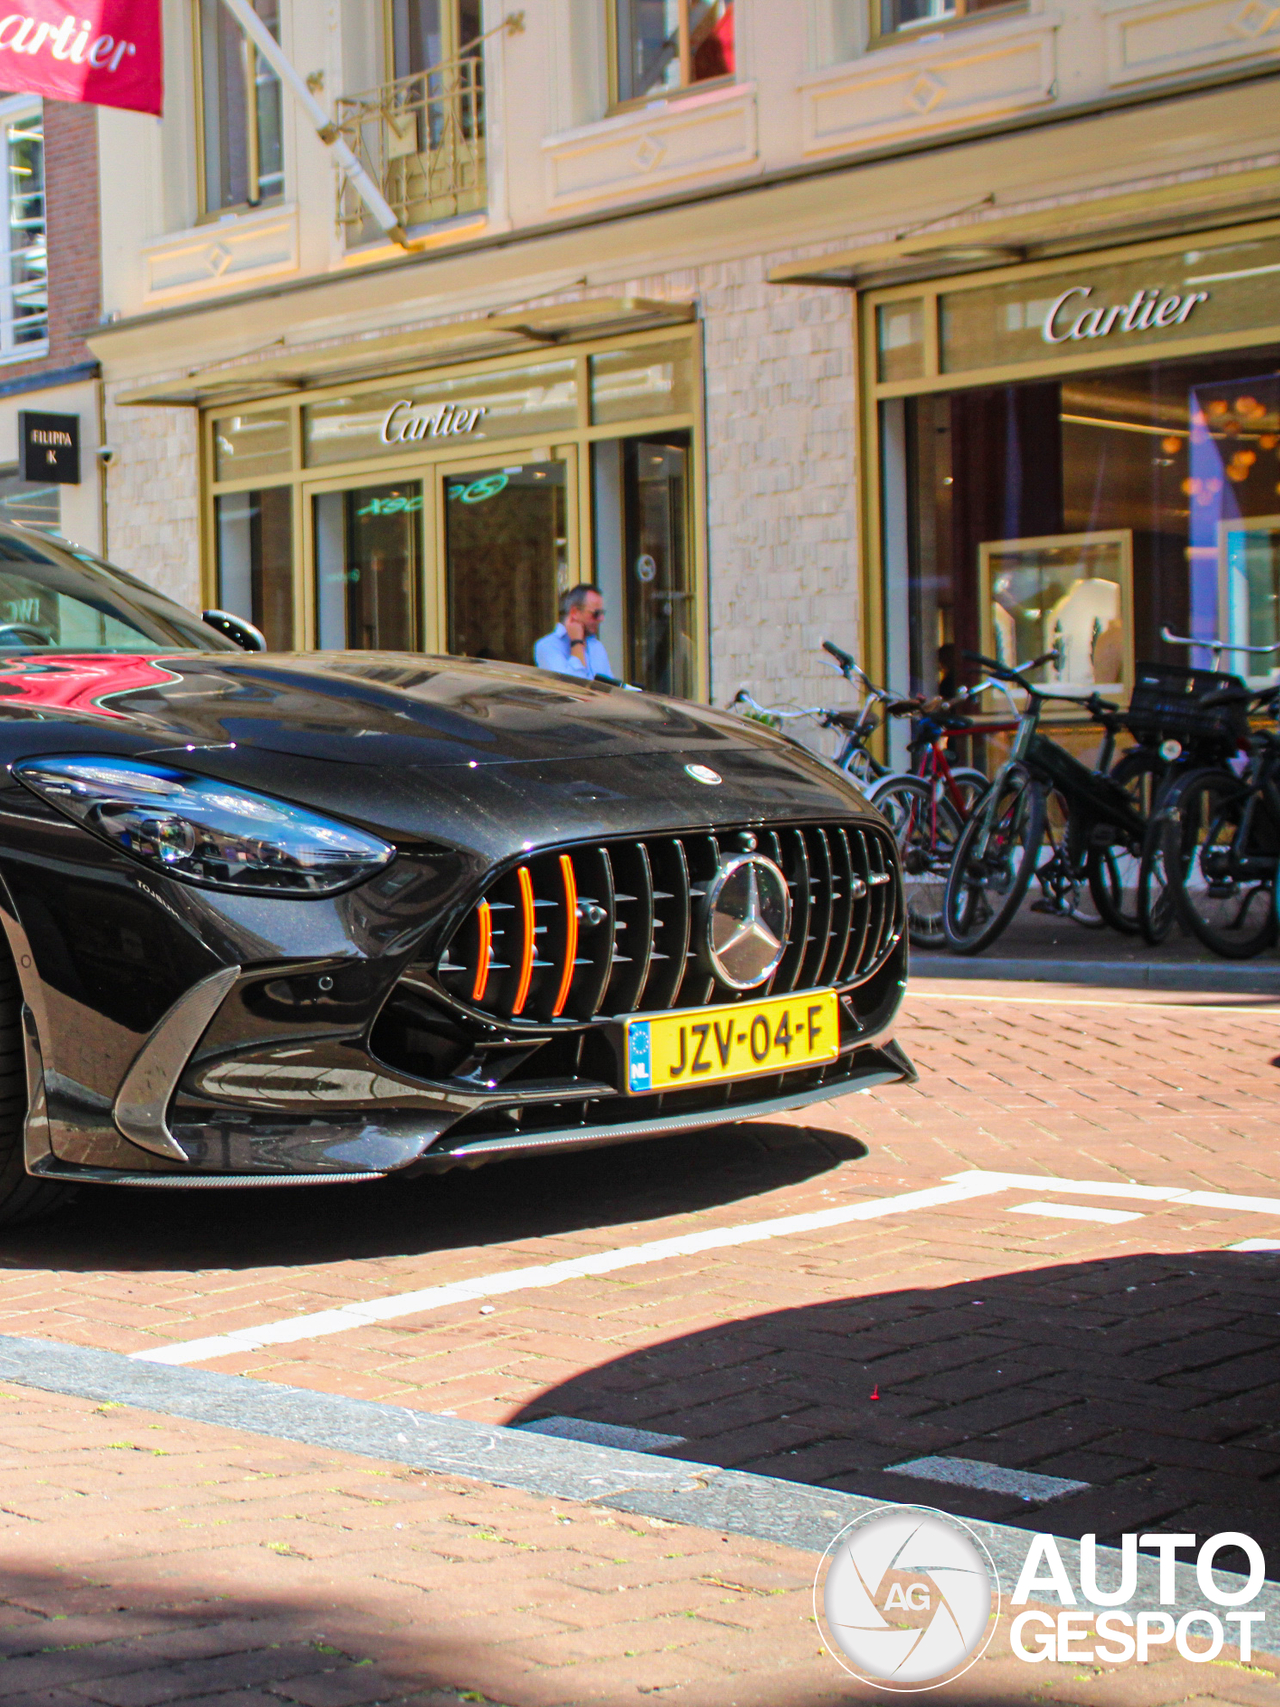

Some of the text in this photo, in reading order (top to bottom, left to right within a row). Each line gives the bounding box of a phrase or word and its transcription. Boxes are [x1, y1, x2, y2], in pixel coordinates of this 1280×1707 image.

[1042, 286, 1209, 344] Cartier
[381, 400, 487, 444] Cartier
[30, 429, 72, 446] FILIPPA
[46, 450, 57, 464] K
[670, 1005, 823, 1078] JZV-04-F
[631, 1062, 649, 1079] NL
